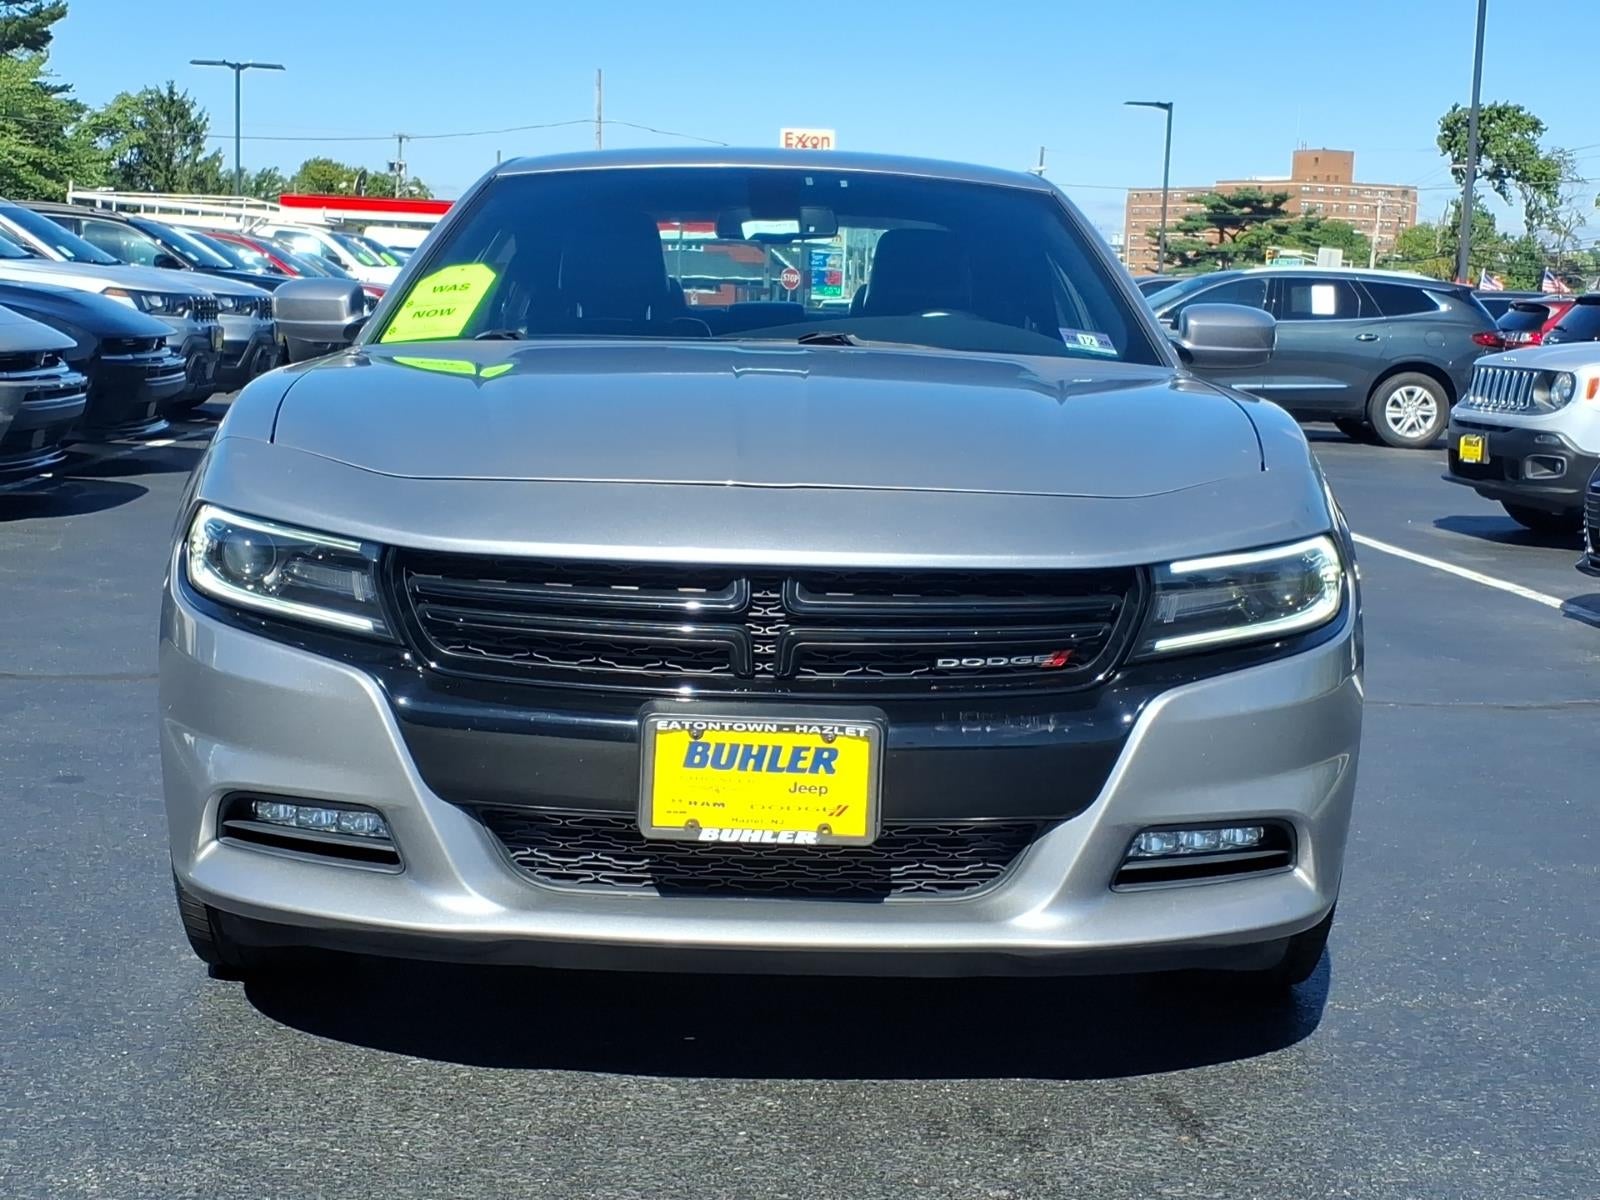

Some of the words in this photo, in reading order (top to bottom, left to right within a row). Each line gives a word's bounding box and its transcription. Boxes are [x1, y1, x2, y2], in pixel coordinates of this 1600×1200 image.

[784, 131, 831, 150] Exxon
[783, 273, 799, 283] STOP
[432, 282, 471, 293] WAS
[412, 307, 456, 318] NOW
[937, 655, 1053, 668] DODGE
[656, 720, 777, 733] EATONTOWN
[795, 724, 869, 737] HAZLET
[683, 741, 839, 775] BUHLER
[788, 781, 829, 797] Jeep
[698, 827, 818, 845] BUHLER
